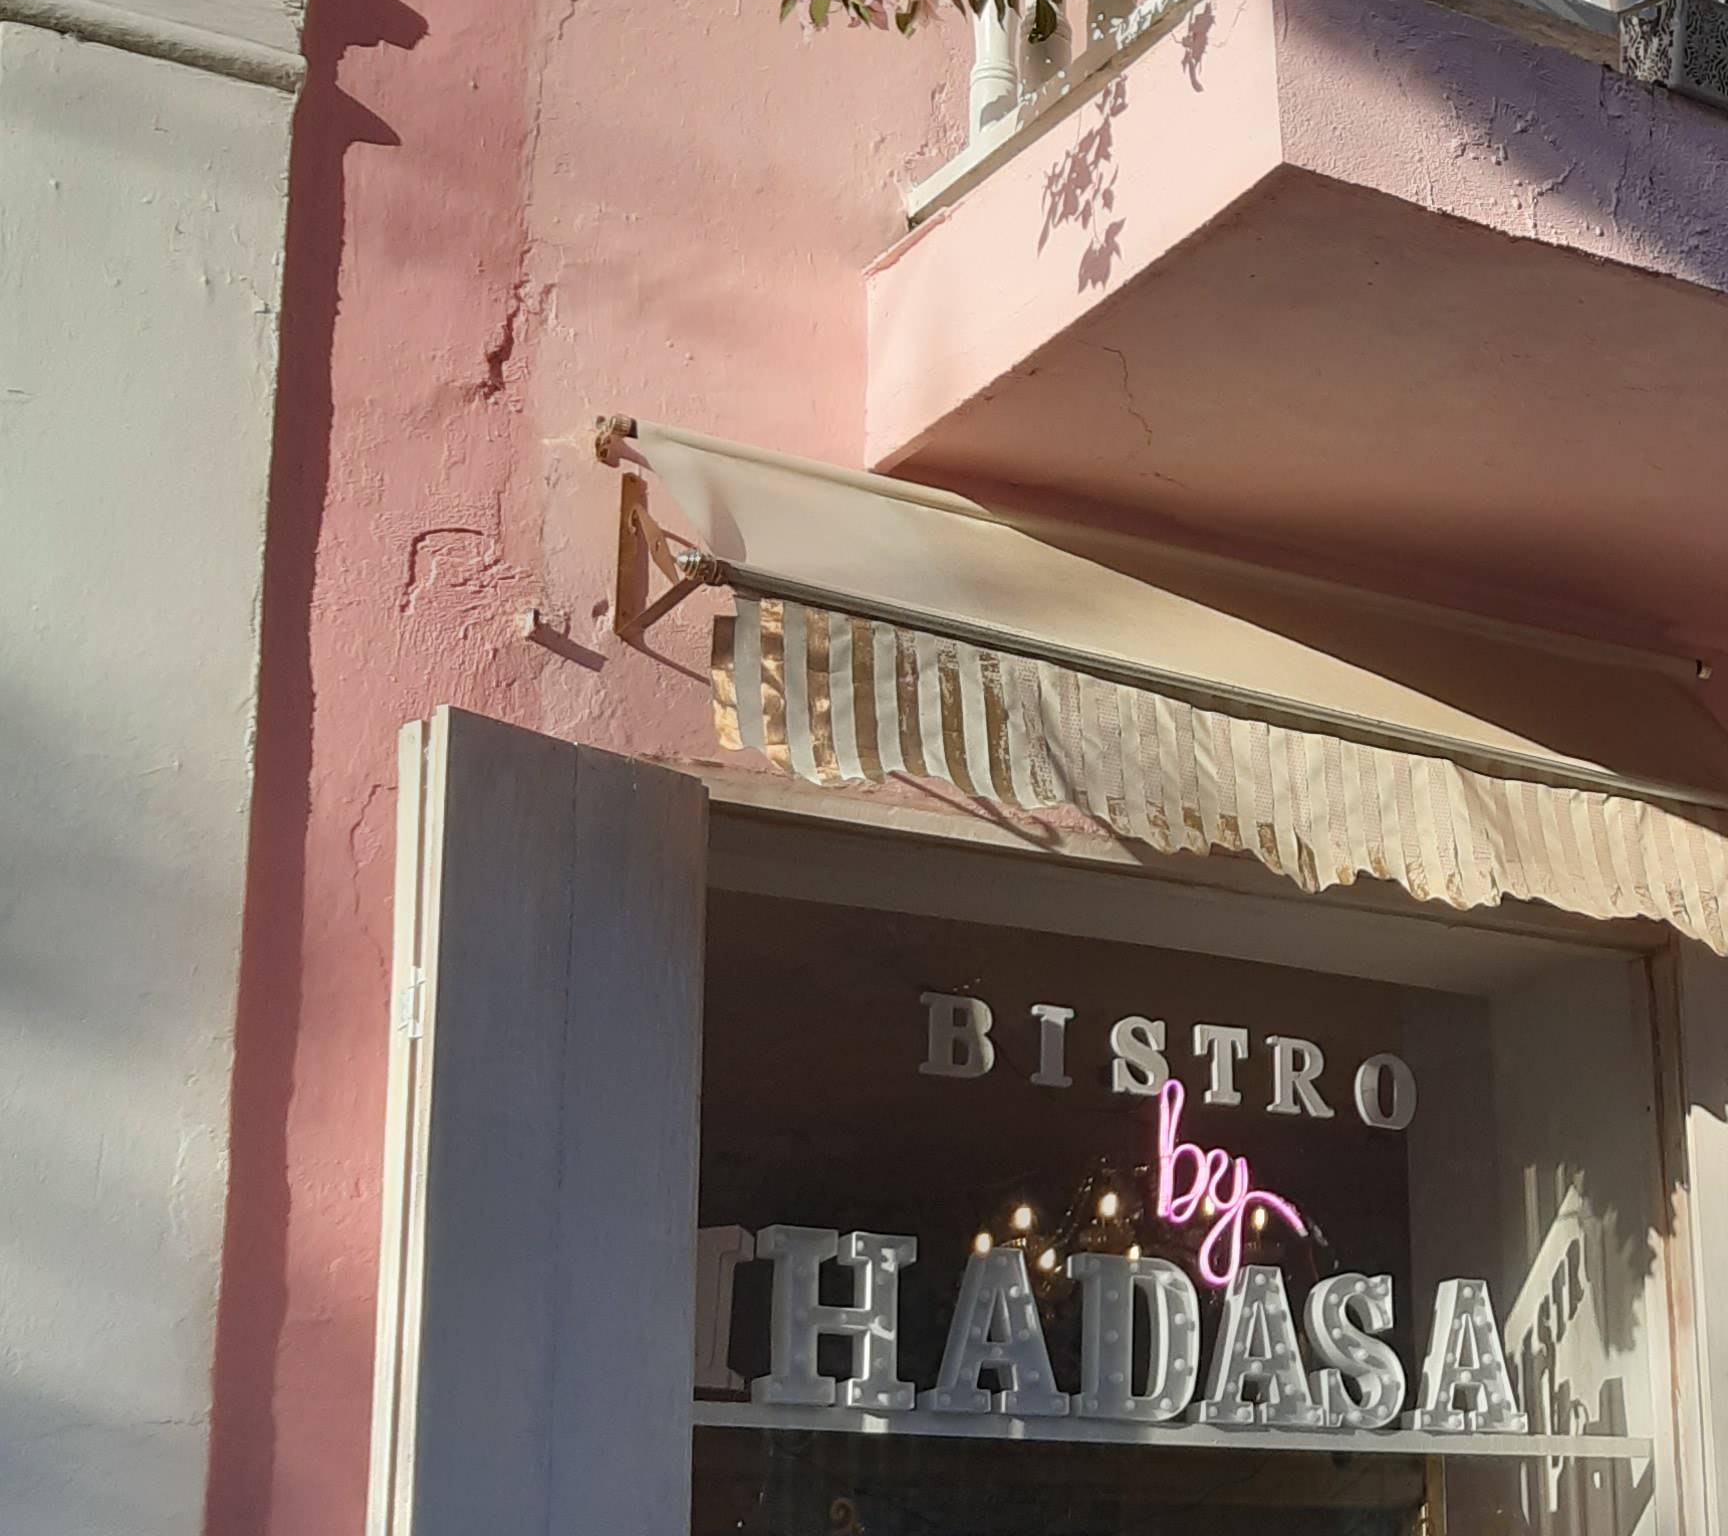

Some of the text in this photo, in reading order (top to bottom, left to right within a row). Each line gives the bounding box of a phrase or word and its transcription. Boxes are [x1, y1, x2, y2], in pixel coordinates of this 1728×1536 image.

[918, 990, 1418, 1131] BISTRO
[1158, 1077, 1306, 1286] by
[751, 1224, 1530, 1434] HADASA
